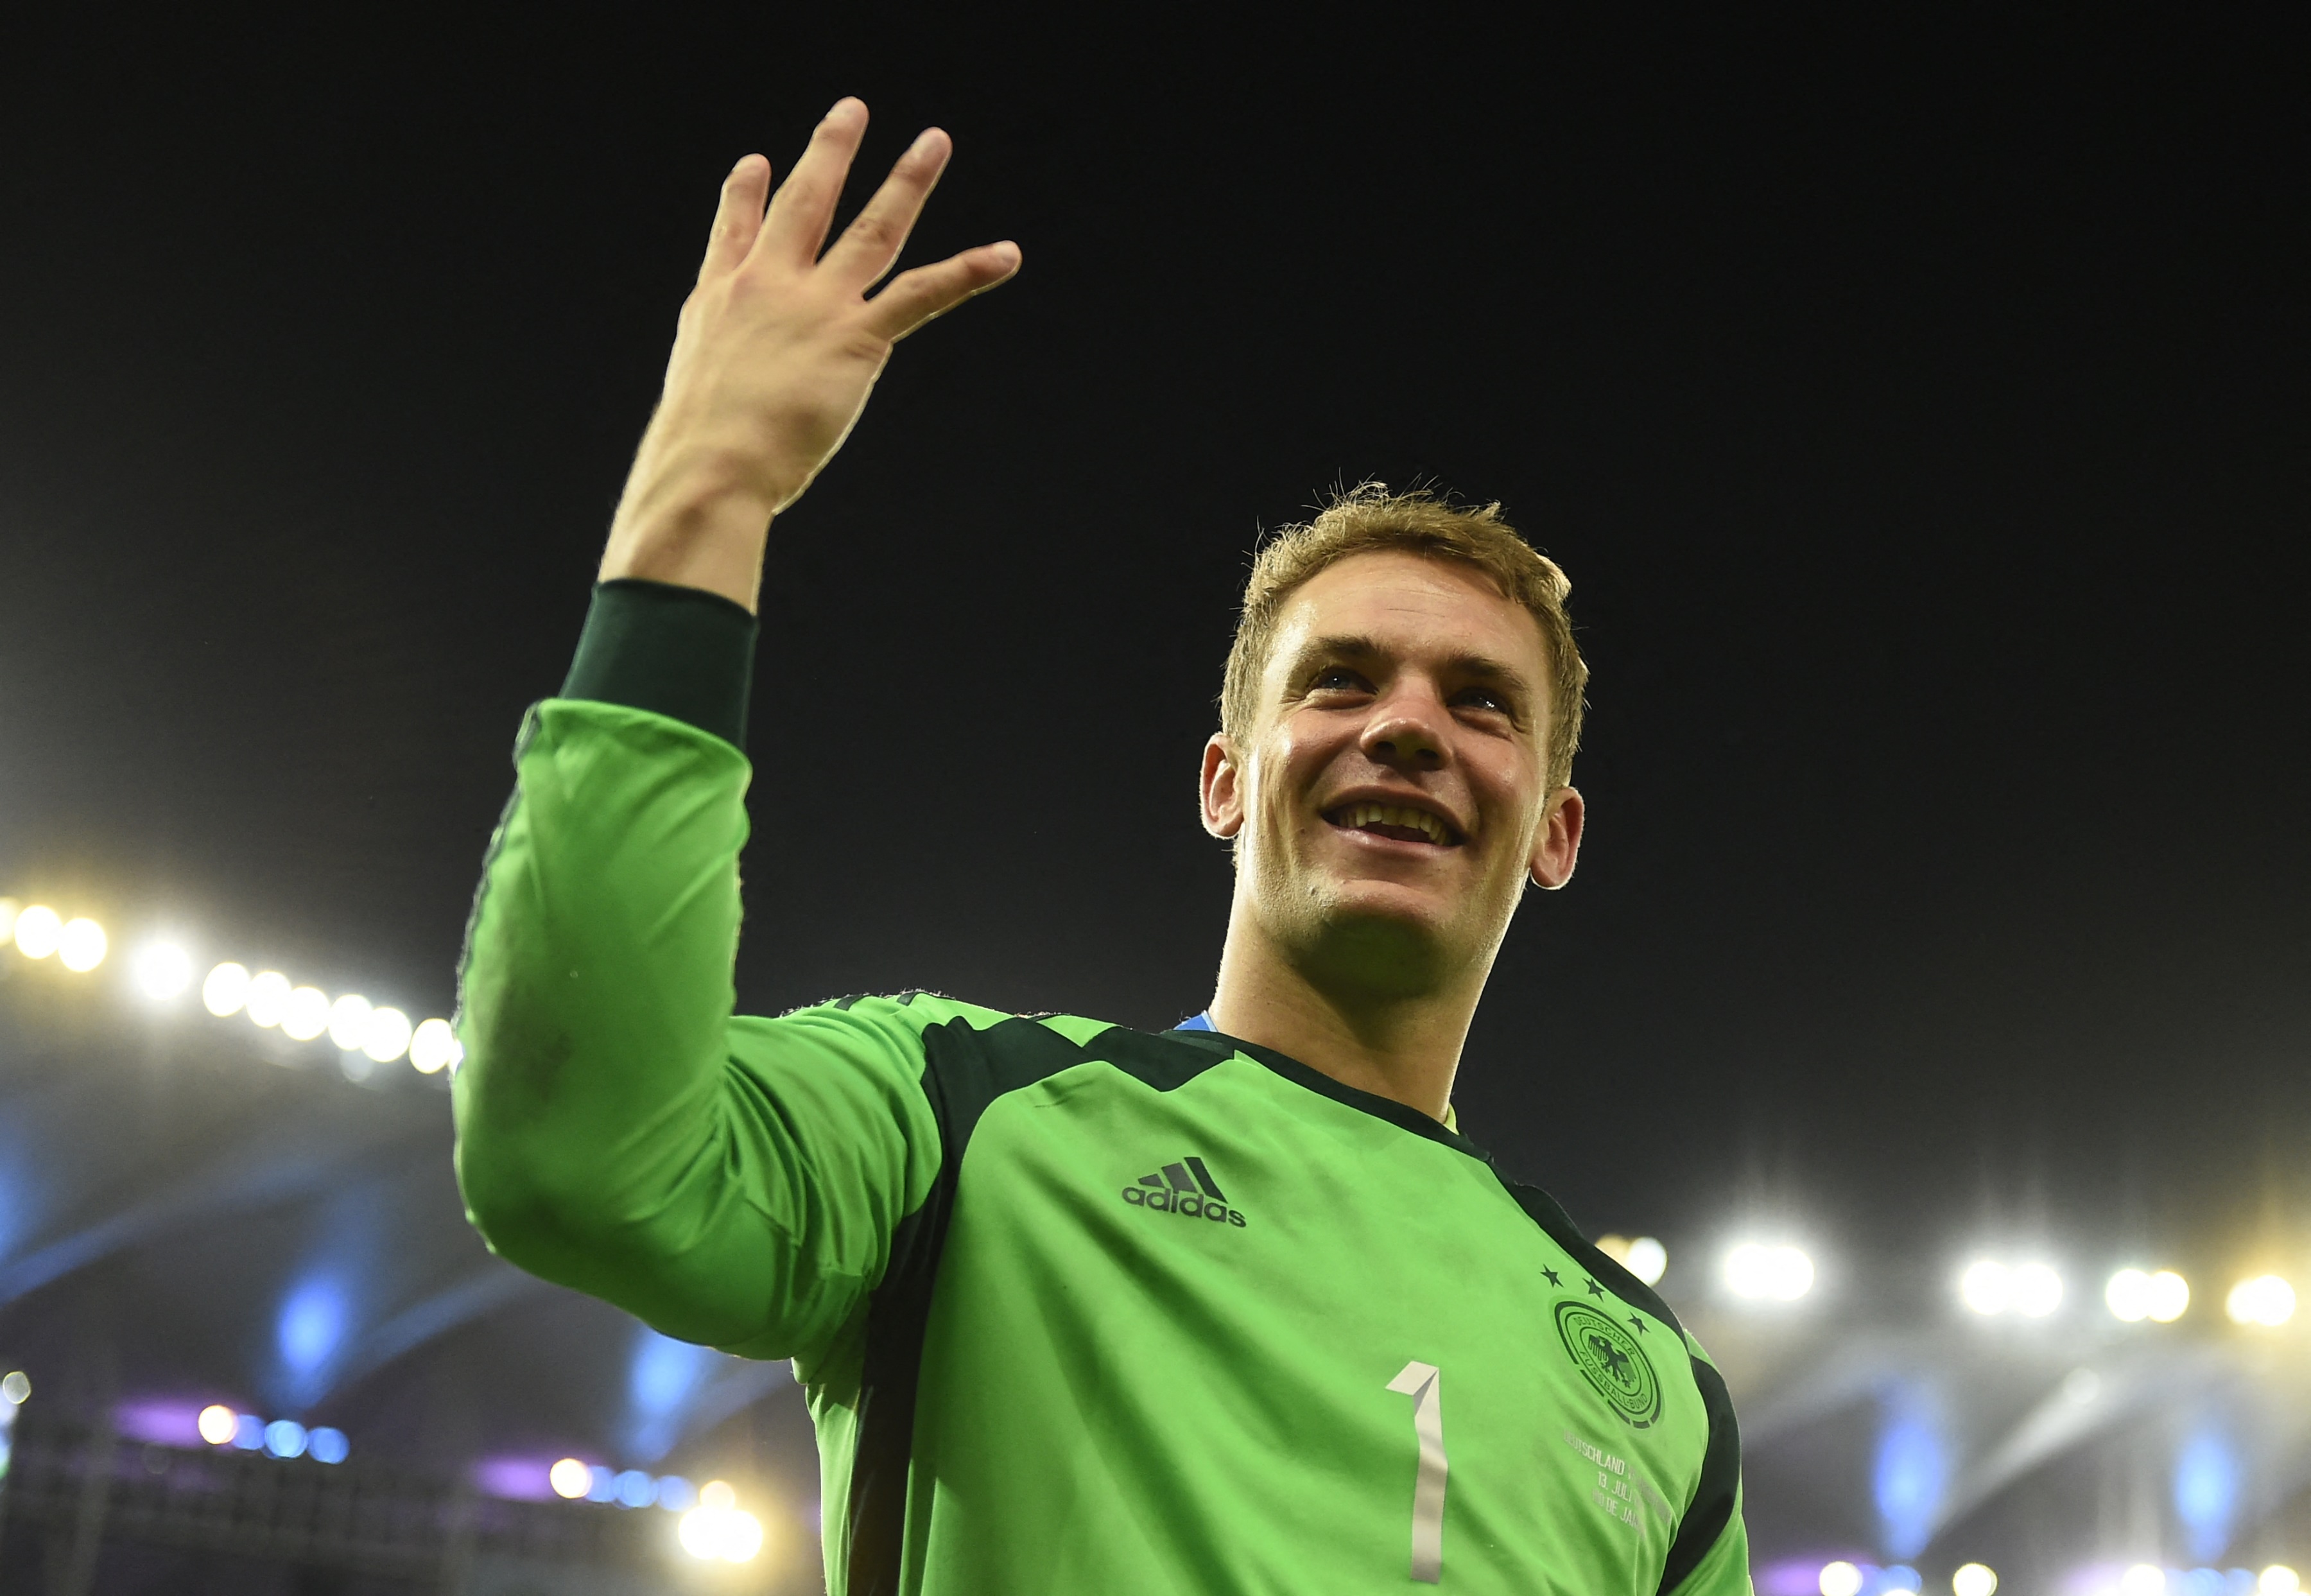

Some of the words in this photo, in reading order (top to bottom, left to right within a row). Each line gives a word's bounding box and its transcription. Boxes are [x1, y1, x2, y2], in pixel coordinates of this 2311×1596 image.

[1122, 1187, 1247, 1228] adidas
[1573, 1316, 1635, 1355] DEUTSCHER
[1579, 1351, 1648, 1409] FUSSBALL-BUND
[1385, 1360, 1448, 1584] 1
[1598, 1471, 1608, 1490] 13.
[1606, 1496, 1618, 1517] DE
